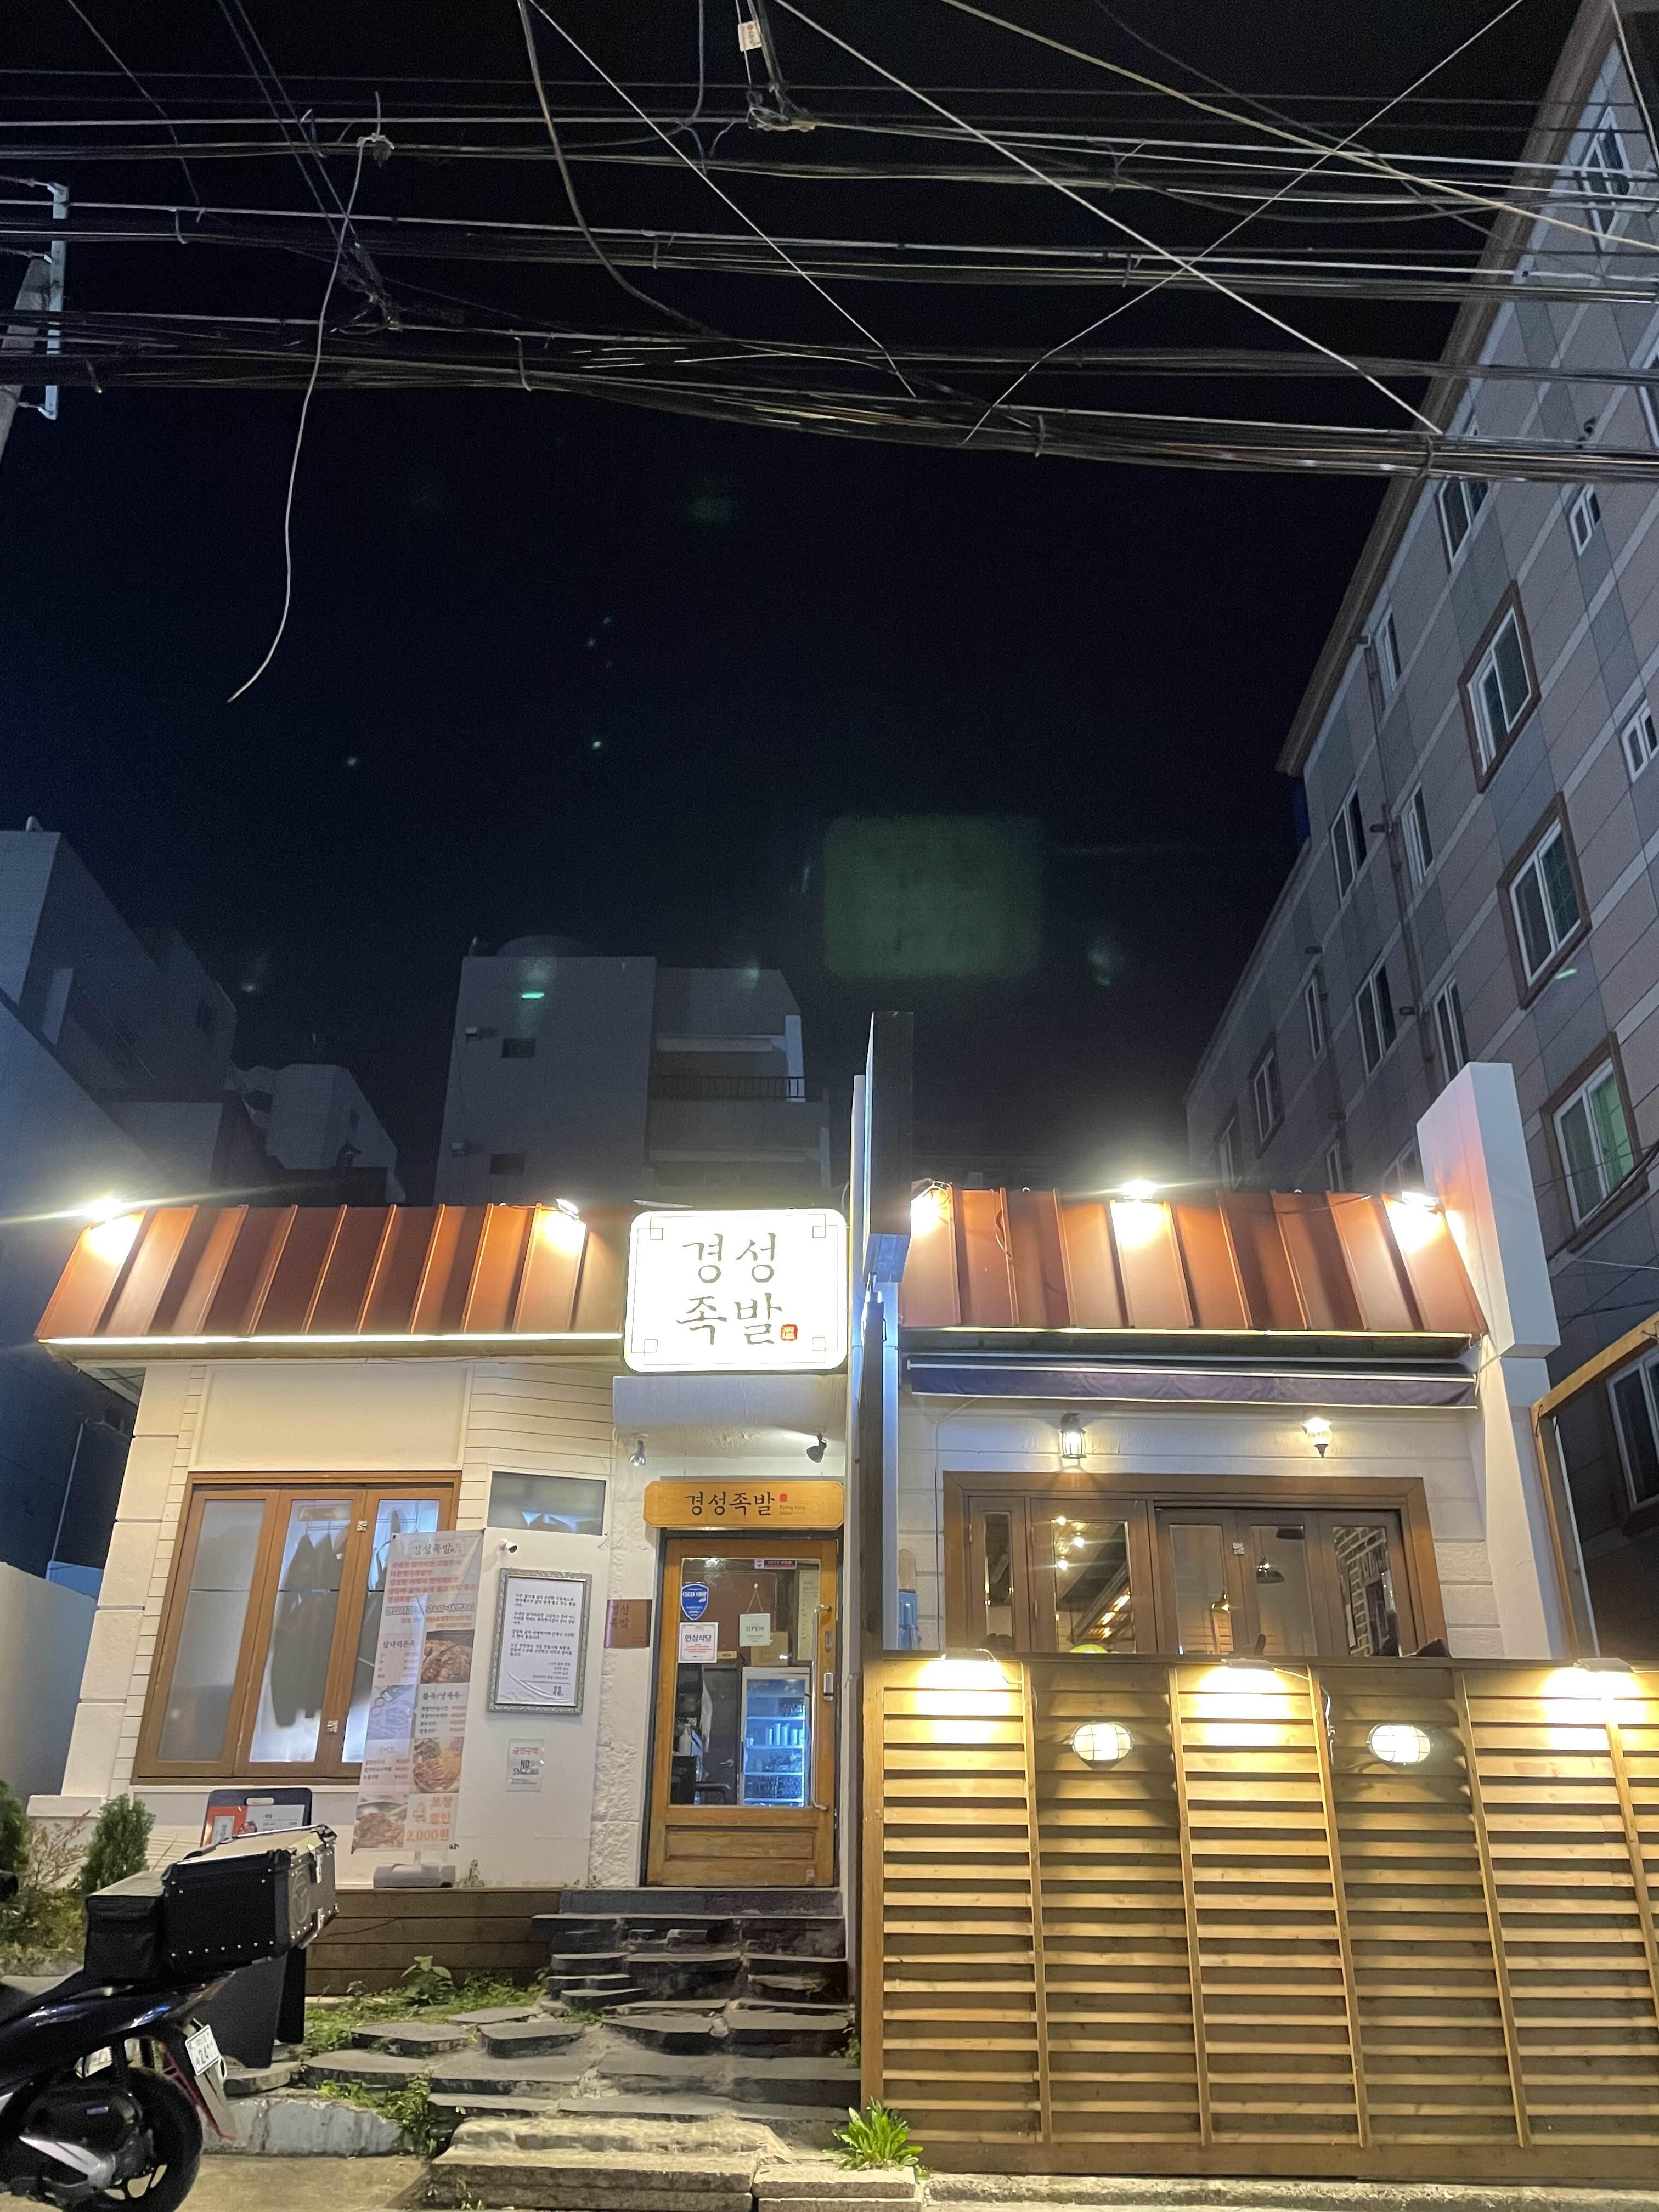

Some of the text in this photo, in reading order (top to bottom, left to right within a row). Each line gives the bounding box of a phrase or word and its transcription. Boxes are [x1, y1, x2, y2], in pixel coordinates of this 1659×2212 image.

[681, 1233, 777, 1284] 경성
[675, 1292, 782, 1345] 족발
[685, 1491, 775, 1516] 경성족발
[685, 1634, 712, 1643] 안심식당
